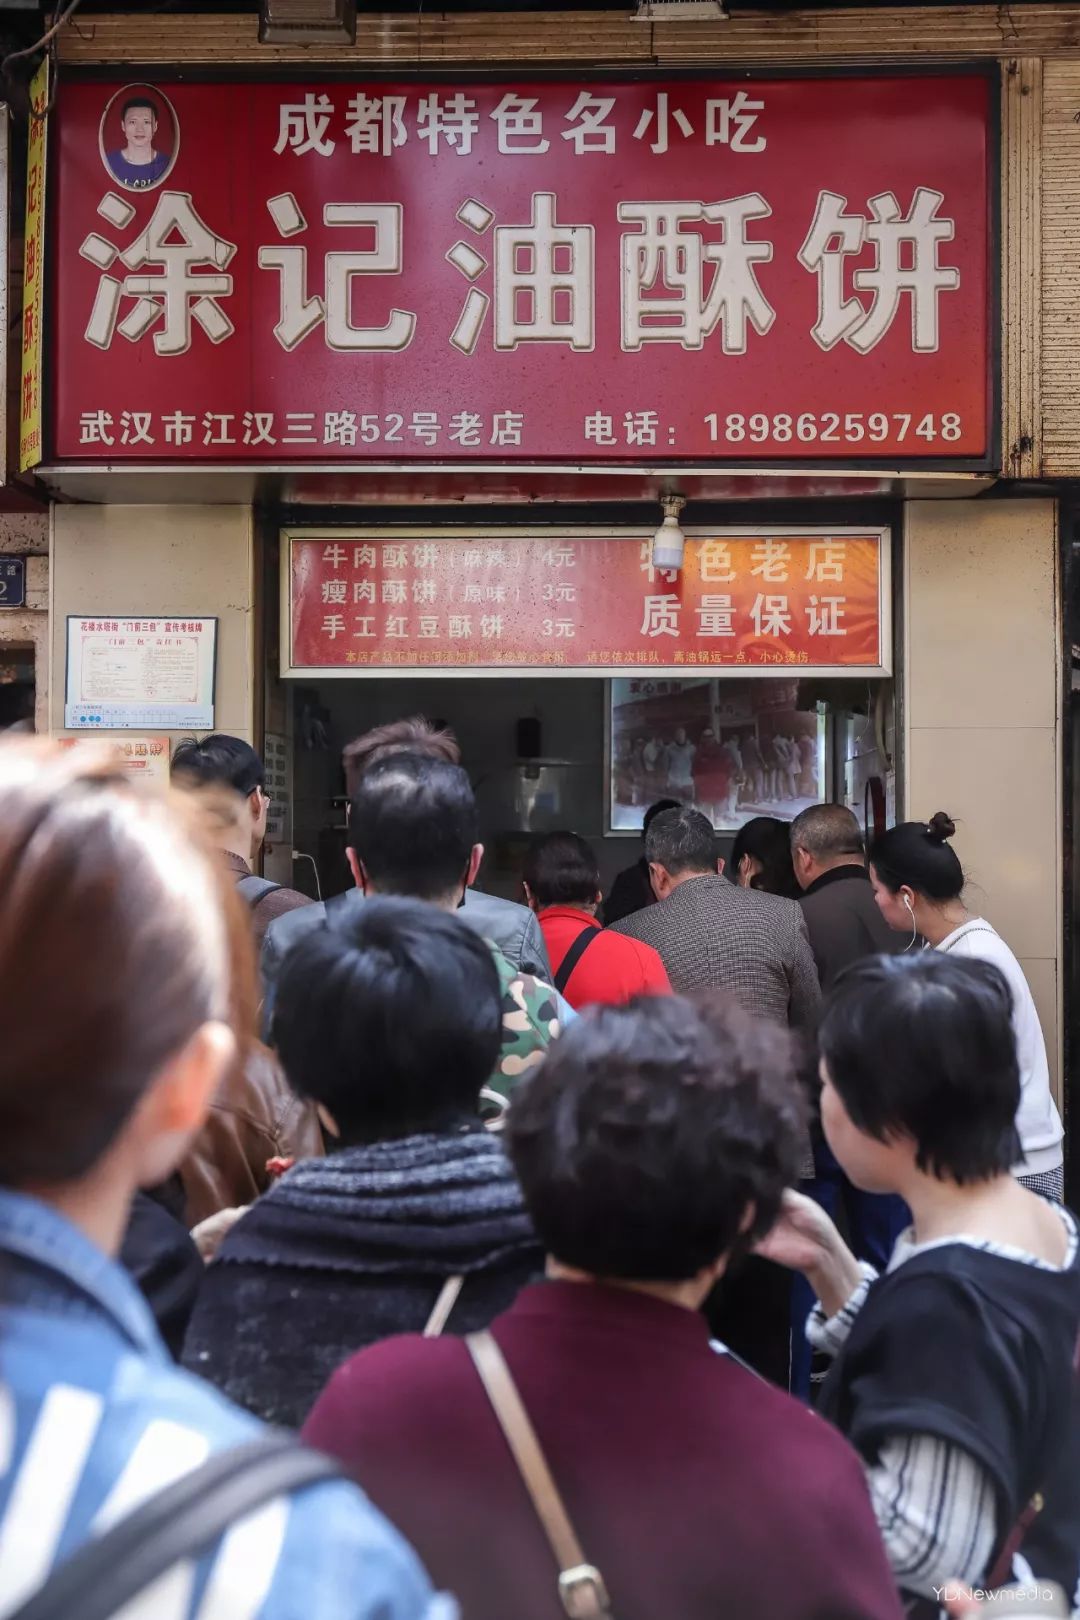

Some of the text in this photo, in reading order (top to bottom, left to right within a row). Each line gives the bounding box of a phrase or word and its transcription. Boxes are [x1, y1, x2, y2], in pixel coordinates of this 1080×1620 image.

[273, 91, 767, 156] 成都特色名小吃
[79, 186, 960, 357] 涂记油酥饼
[79, 410, 523, 446] 武汉市江汉三路52号老店
[542, 582, 577, 603] 3元
[321, 614, 576, 639] 手工红豆酥饼 3元
[640, 592, 847, 638] 质量保证
